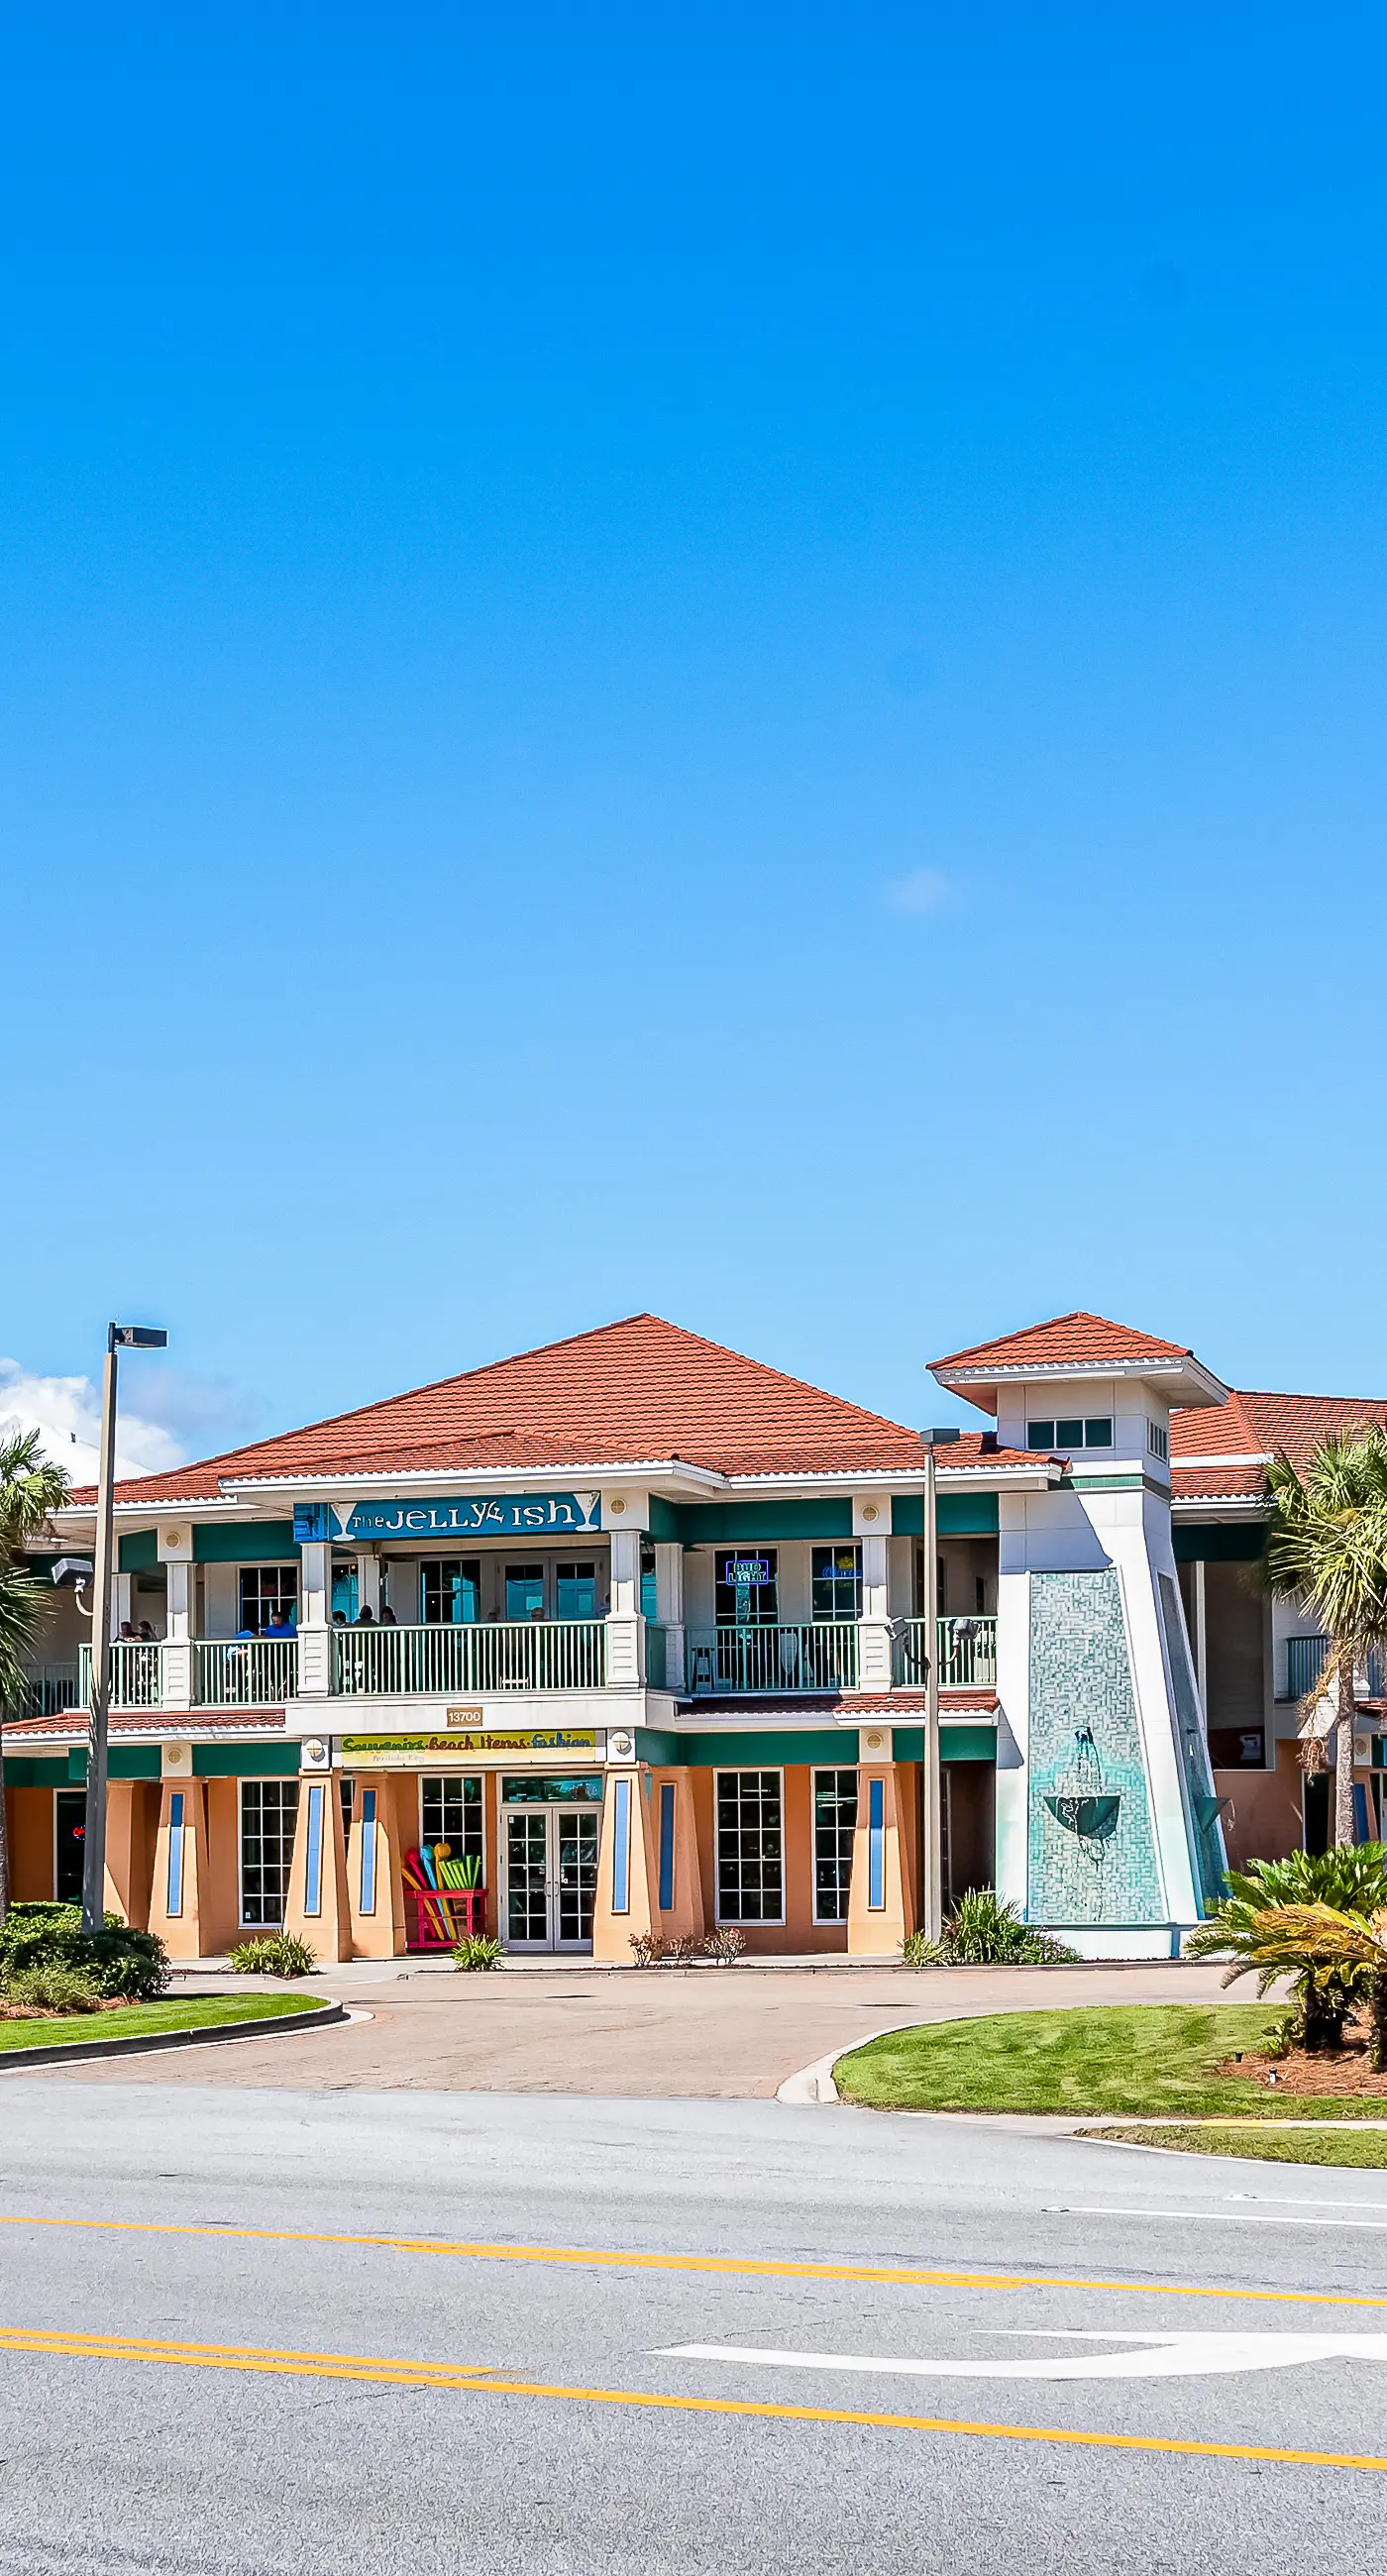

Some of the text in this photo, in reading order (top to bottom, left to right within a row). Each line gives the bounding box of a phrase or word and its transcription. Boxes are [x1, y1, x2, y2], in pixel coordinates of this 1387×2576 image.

[352, 1515, 384, 1528] The
[733, 1562, 761, 1572] BUD
[728, 1571, 767, 1582] LIGHT
[448, 1711, 481, 1723] 13700
[342, 1737, 425, 1753] Souvenirs
[429, 1734, 475, 1751] Beach
[480, 1734, 527, 1750] Items
